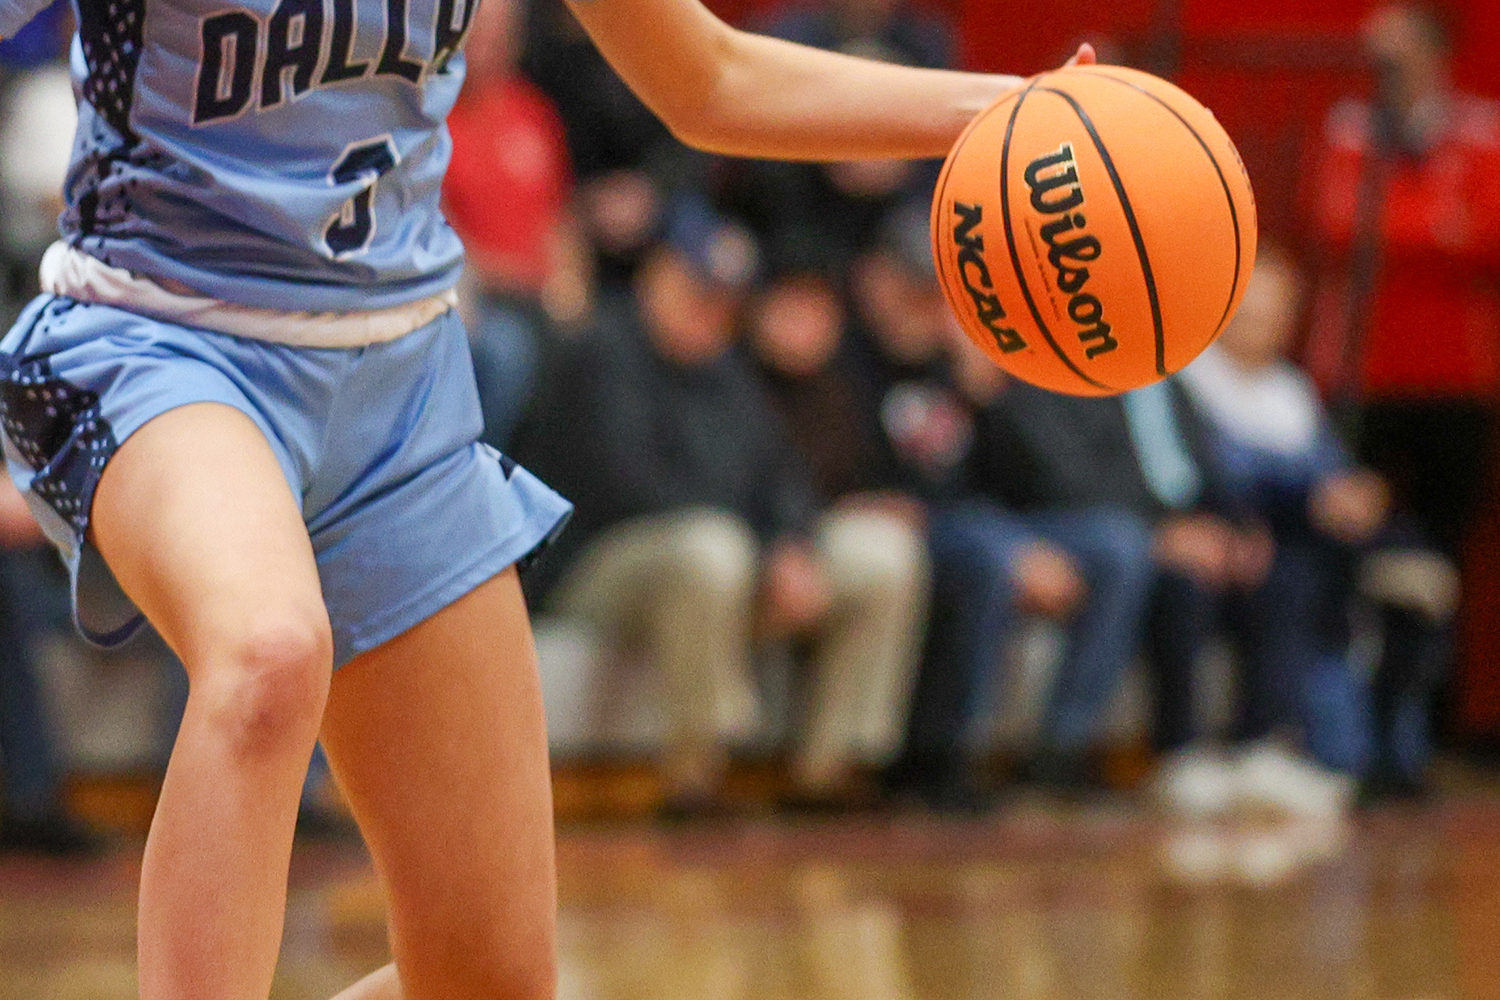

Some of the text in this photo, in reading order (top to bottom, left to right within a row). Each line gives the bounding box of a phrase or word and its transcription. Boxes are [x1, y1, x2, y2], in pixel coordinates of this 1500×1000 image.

[324, 133, 401, 261] 3
[1024, 141, 1118, 360] Wilson
[954, 200, 1028, 354] NCAA
